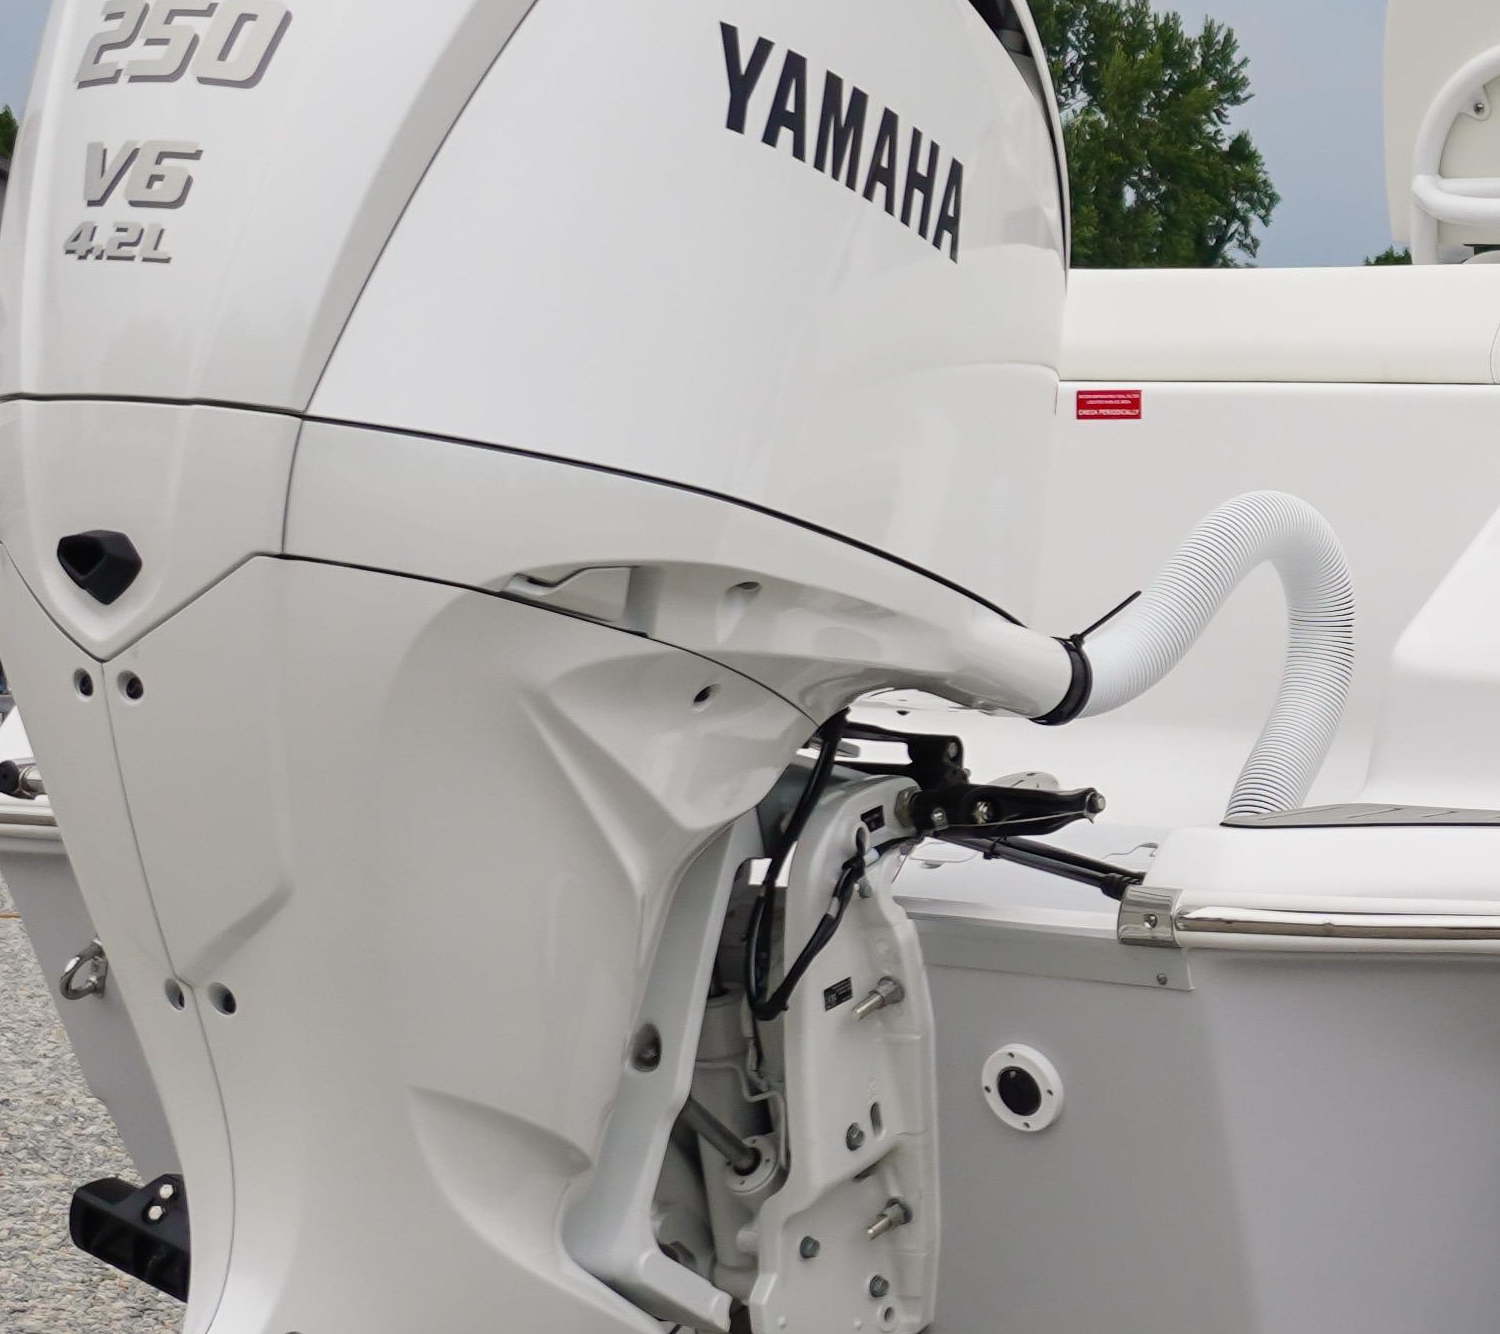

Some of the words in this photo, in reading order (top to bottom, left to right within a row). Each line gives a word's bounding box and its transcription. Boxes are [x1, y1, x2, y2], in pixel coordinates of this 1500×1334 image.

[84, 140, 204, 209] V6
[719, 21, 964, 264] YAMAHA
[63, 221, 172, 263] 4.2L
